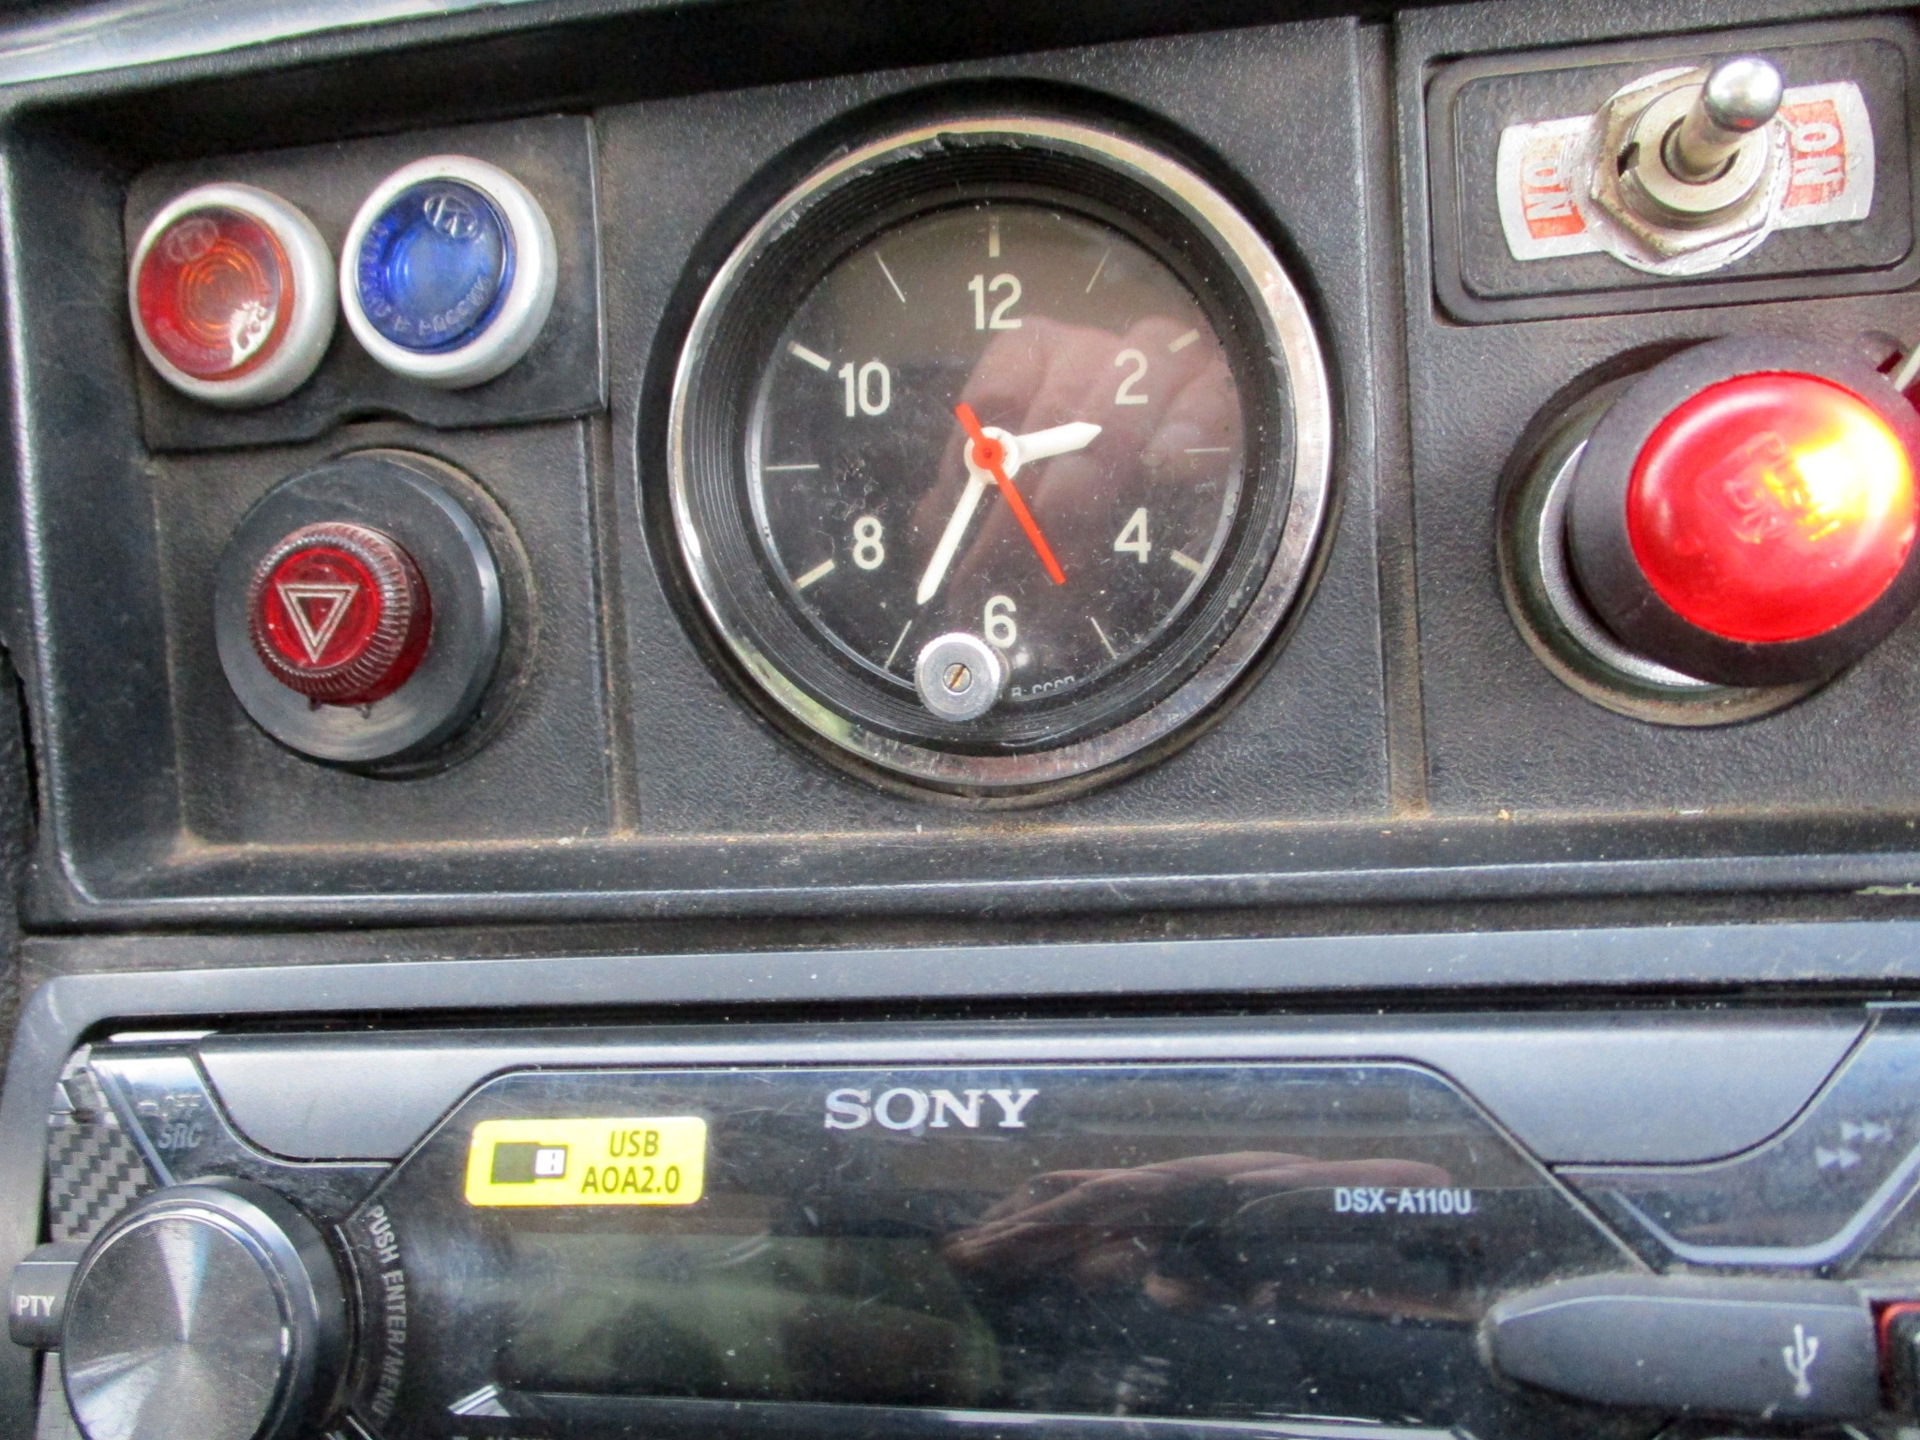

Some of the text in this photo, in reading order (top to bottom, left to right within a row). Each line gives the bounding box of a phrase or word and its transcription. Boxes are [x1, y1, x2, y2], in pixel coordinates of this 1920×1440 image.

[1793, 122, 1841, 186] ON
[1524, 160, 1574, 220] ON
[967, 273, 1023, 331] 12
[838, 348, 1149, 418] 10 2
[852, 507, 1153, 571] 8 4
[983, 594, 1018, 649] 6
[824, 1087, 1040, 1130] SONY
[610, 1130, 660, 1158] USB
[581, 1165, 681, 1195] AOA2.0
[1334, 1187, 1472, 1215] DSX-A110U
[15, 1294, 56, 1317] PTY
[366, 1204, 407, 1419] PUSH ENTER/MENU
